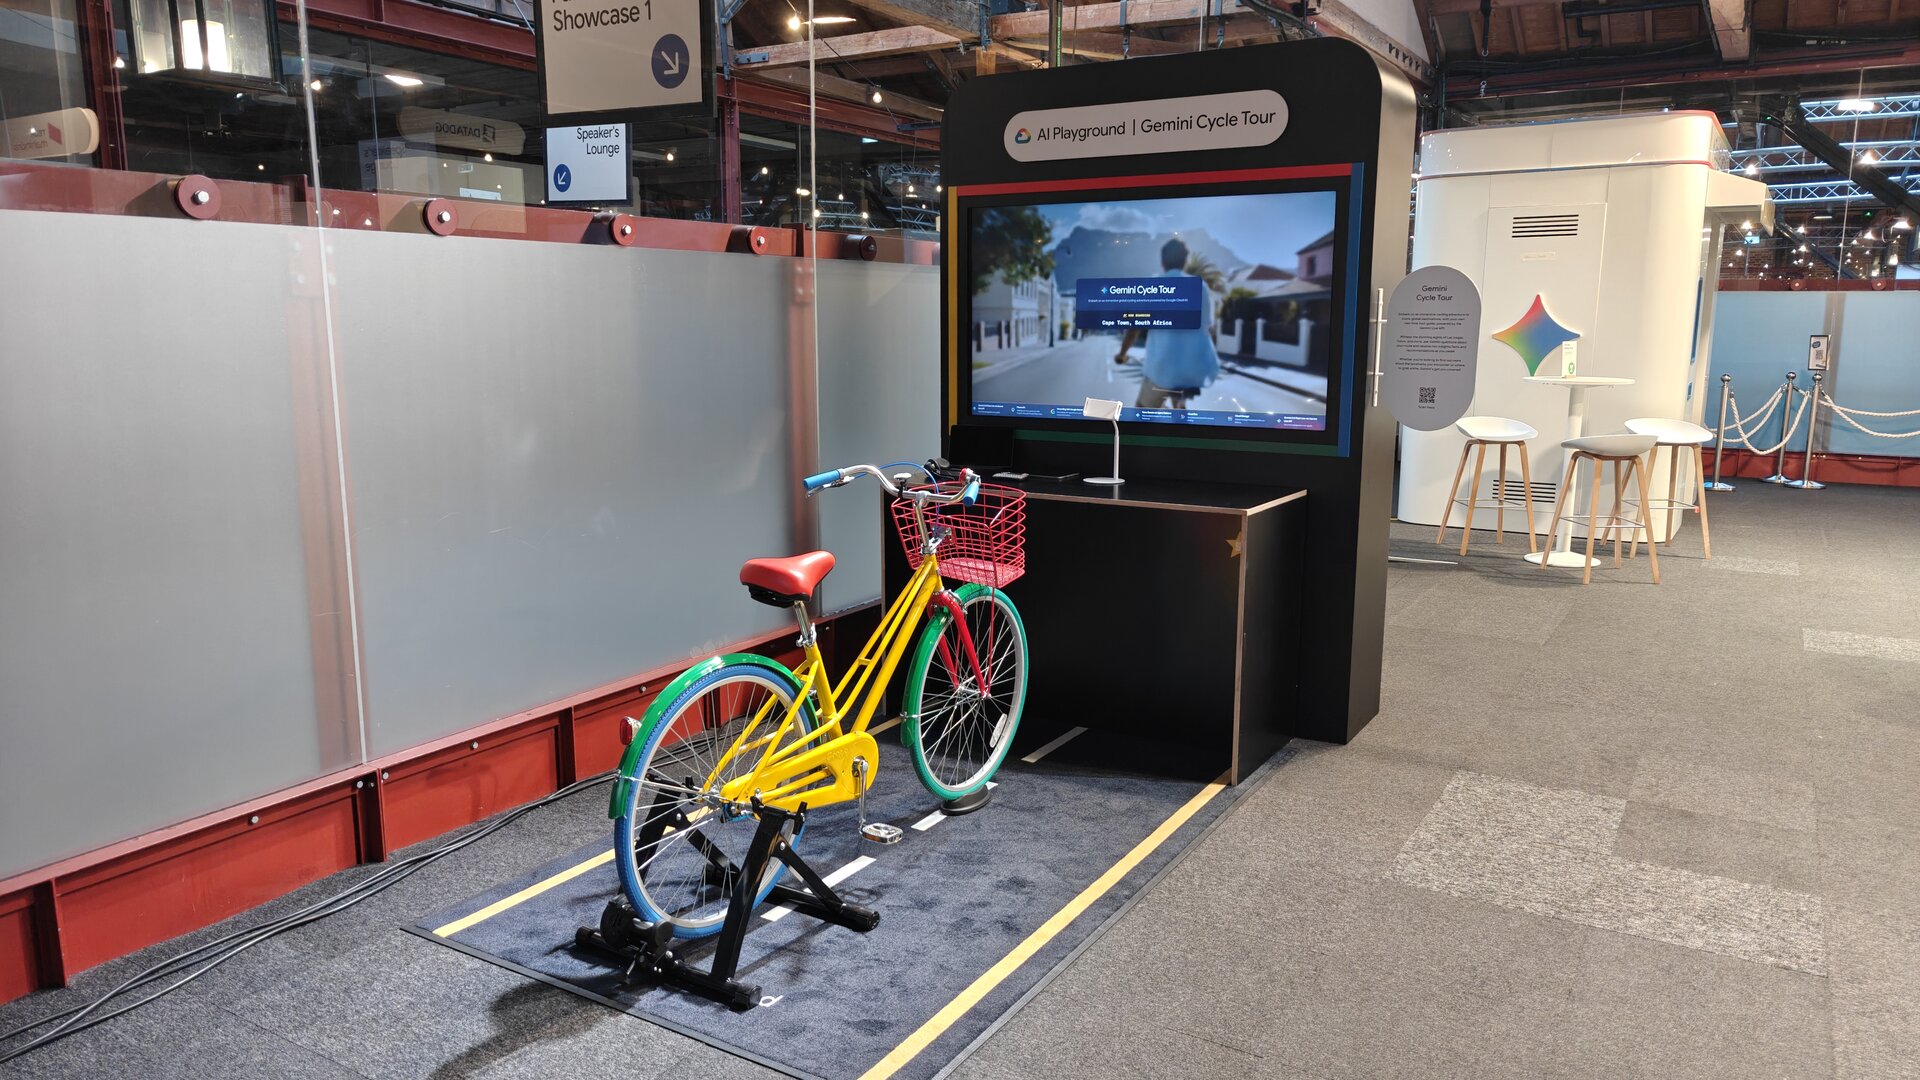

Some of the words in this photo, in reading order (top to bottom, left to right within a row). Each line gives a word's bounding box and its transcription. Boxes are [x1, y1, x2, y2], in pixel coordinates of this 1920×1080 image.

[553, 5, 640, 32] Showcase
[645, 0, 652, 21] 1
[576, 125, 620, 142] Speaker's
[1037, 127, 1050, 141] AI
[1053, 121, 1126, 142] Playground
[1141, 115, 1193, 133] Gemini
[1196, 112, 1238, 132] Cycle
[1241, 110, 1276, 126] Tour
[586, 142, 620, 157] Lounge
[1109, 285, 1136, 294] Gemini
[1136, 285, 1158, 296] Cycle
[1158, 285, 1176, 294] Tour
[1416, 294, 1436, 302] Cycle
[1102, 319, 1115, 327] Cape
